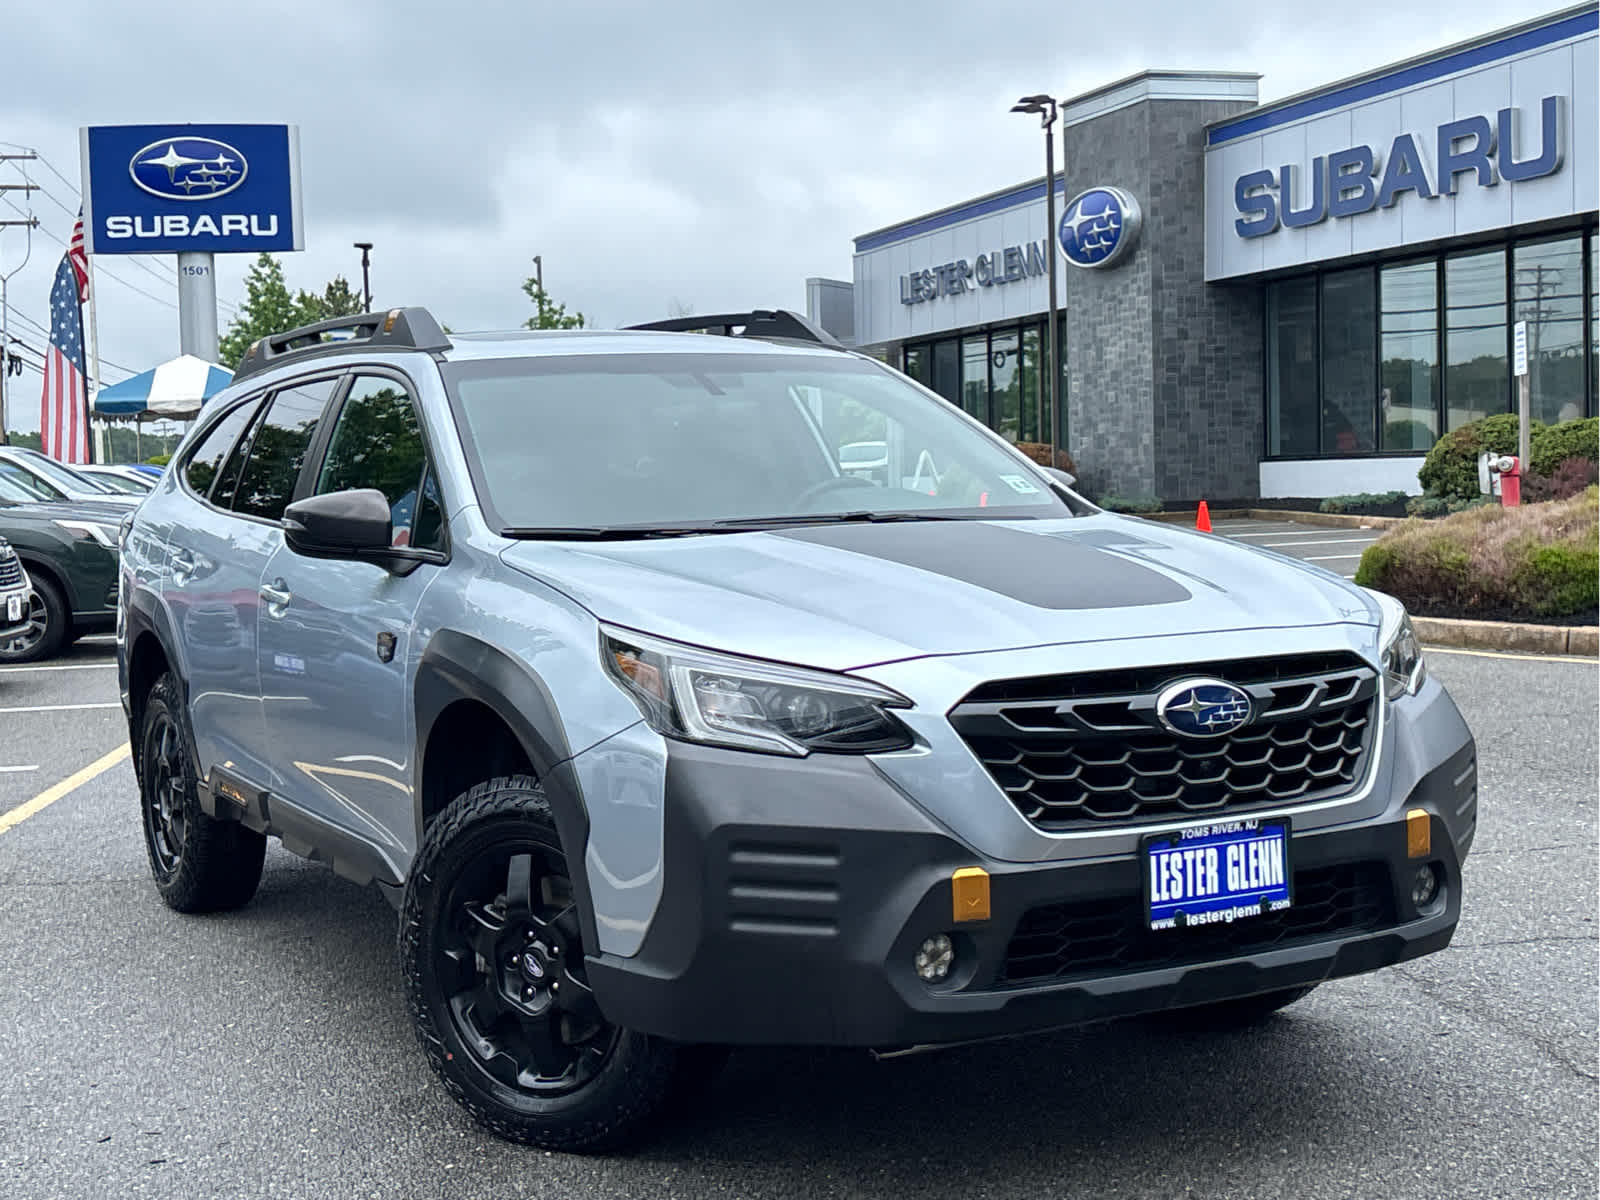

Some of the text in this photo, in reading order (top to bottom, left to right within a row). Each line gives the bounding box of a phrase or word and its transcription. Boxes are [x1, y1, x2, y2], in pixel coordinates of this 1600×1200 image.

[1234, 96, 1564, 238] SUBARU
[106, 215, 278, 238] SUBARU
[183, 265, 209, 276] 1501
[900, 239, 1048, 305] LESTER GLENN
[1180, 820, 1259, 840] TOMS RIVER, NJ
[1150, 838, 1284, 902] LESTER GLENN
